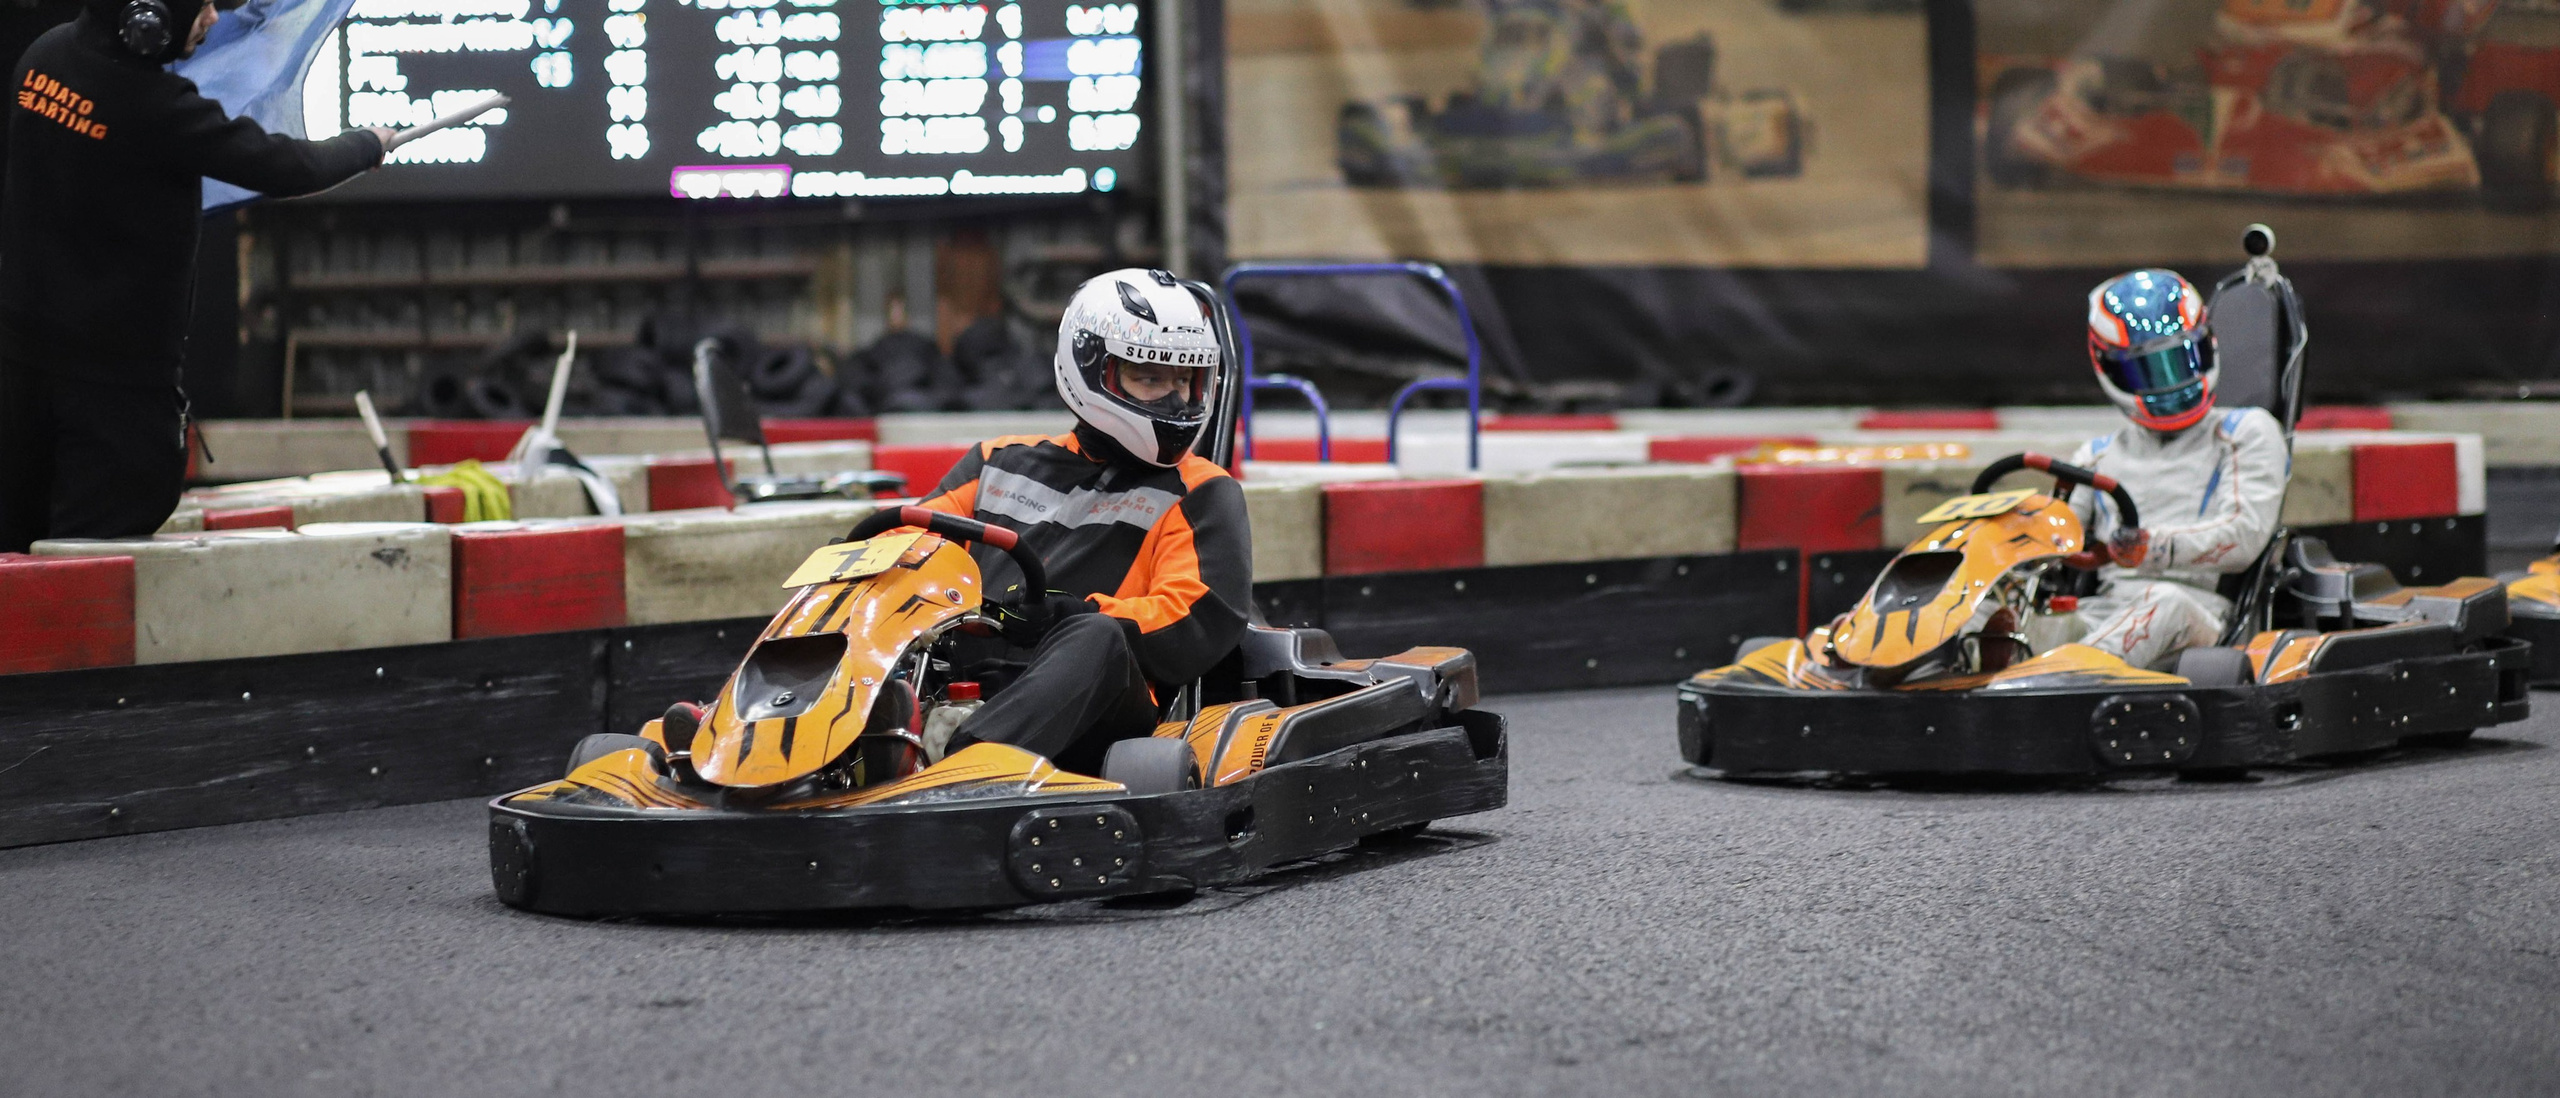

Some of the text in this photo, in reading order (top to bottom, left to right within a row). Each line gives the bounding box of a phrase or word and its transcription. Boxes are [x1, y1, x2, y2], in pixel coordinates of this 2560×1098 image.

[23, 69, 94, 116] LONATO
[18, 90, 108, 140] KARTING
[1126, 346, 1173, 363] SLOW
[1178, 352, 1204, 365] CAR
[1943, 497, 2018, 515] 10
[1261, 722, 1273, 733] OF
